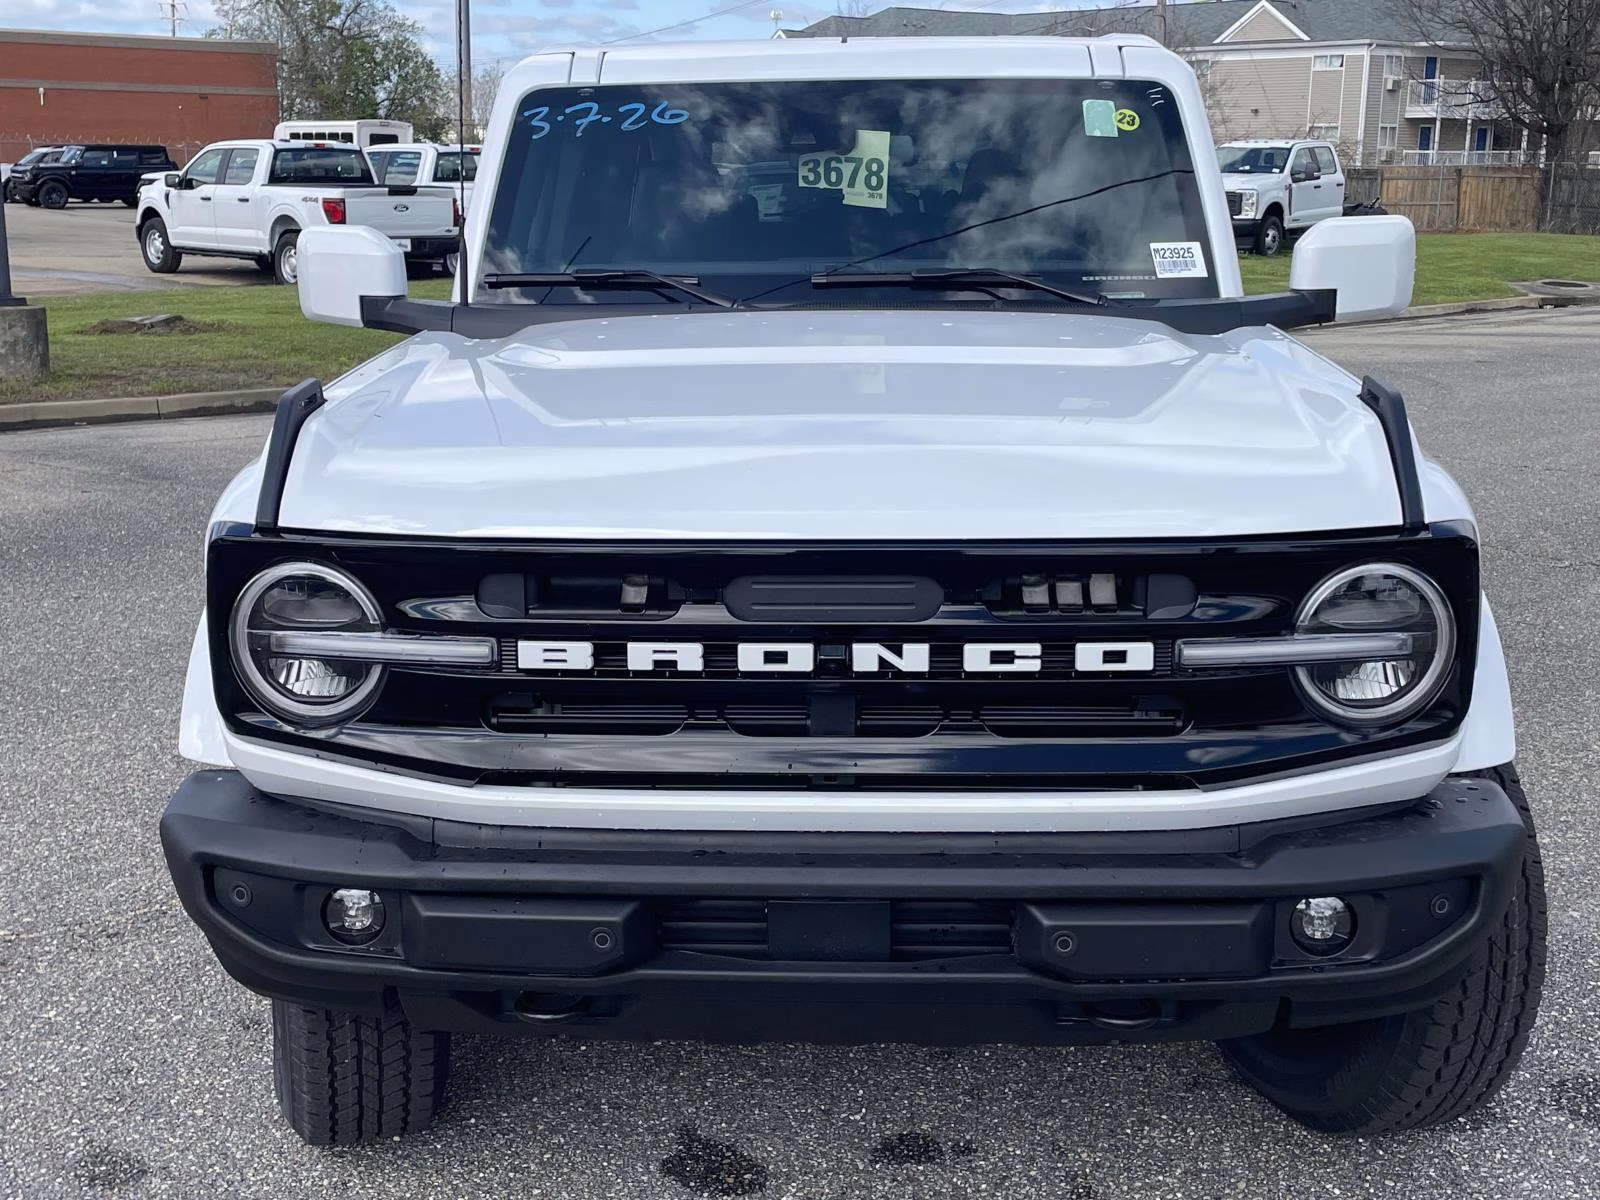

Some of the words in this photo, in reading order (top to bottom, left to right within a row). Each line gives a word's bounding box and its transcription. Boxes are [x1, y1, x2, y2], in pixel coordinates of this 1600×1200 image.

[1117, 111, 1136, 127] 23
[801, 156, 885, 192] 3678
[1153, 247, 1194, 259] M23925
[517, 640, 1154, 672] BRONCO
